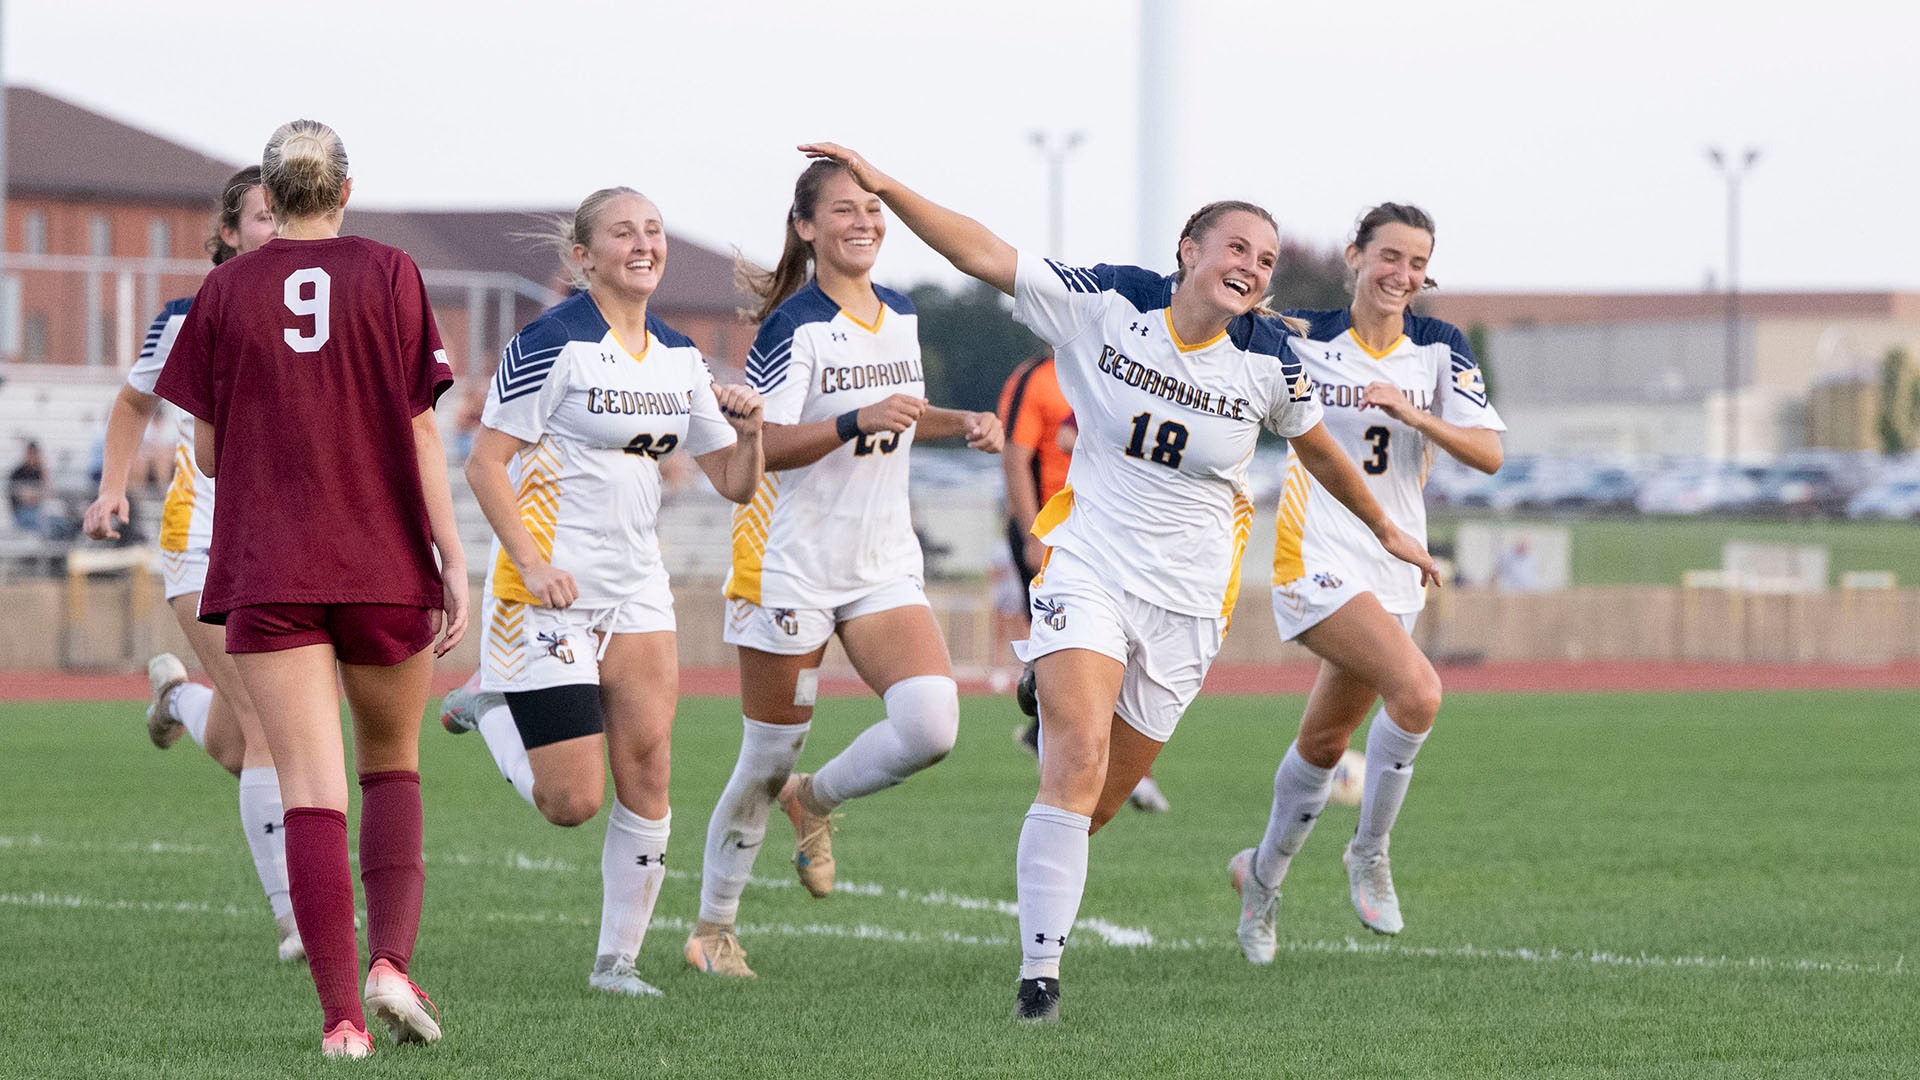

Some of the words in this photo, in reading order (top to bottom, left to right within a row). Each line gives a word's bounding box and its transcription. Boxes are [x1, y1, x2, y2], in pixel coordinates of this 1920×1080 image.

[284, 266, 331, 353] 9
[821, 359, 925, 394] CEDARVILL
[1098, 343, 1250, 421] CEDARVILLE
[1124, 410, 1190, 470] 18
[1362, 425, 1391, 476] 3
